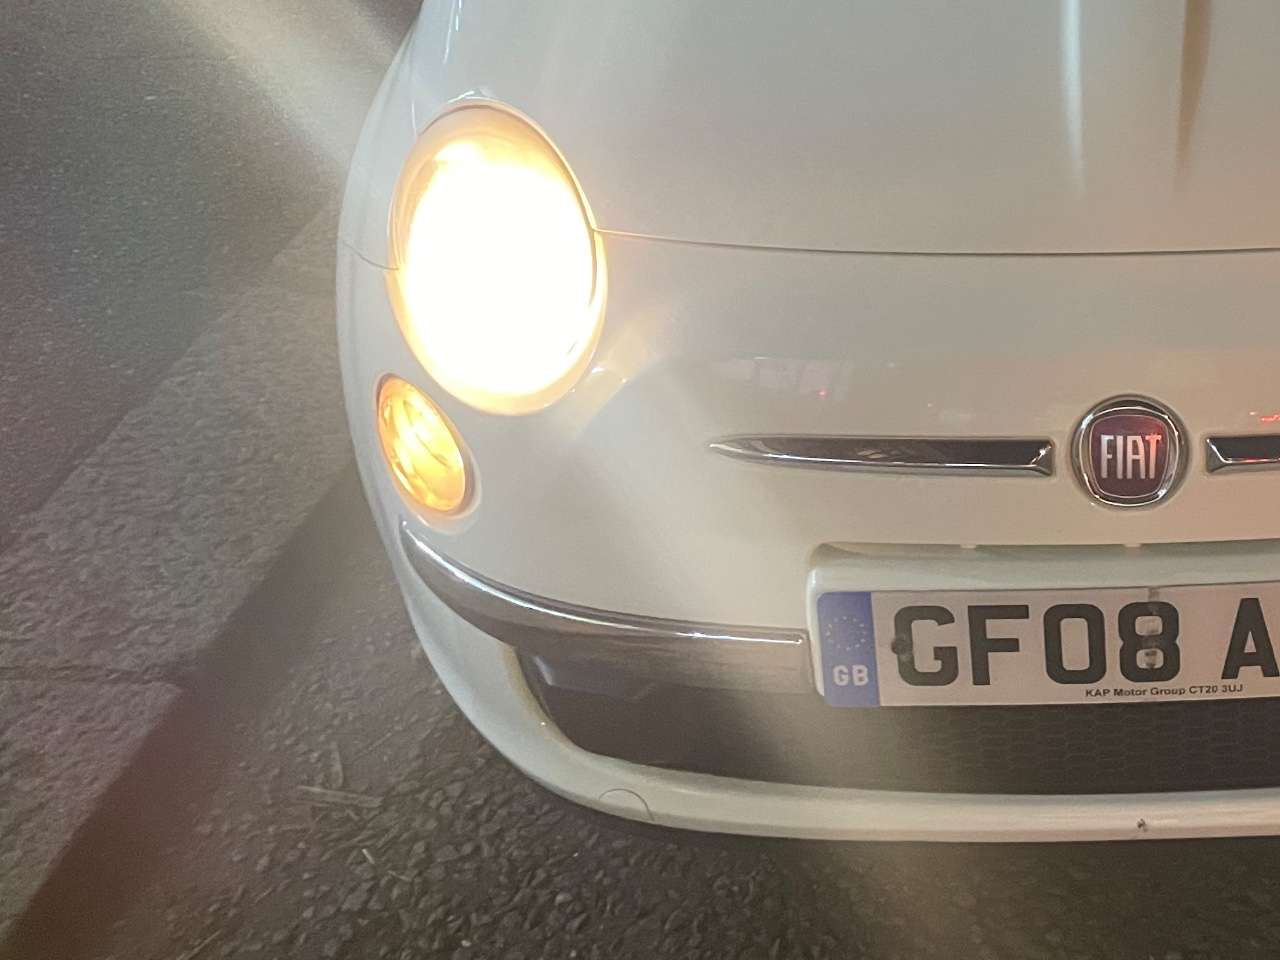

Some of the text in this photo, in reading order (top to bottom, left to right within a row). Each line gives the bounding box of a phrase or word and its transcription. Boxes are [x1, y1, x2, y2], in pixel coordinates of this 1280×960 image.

[1100, 434, 1162, 480] FIAT
[892, 601, 1181, 687] GF08
[832, 664, 869, 687] GB
[1085, 683, 1244, 697] KAP Motor Group CT20 3UJ
